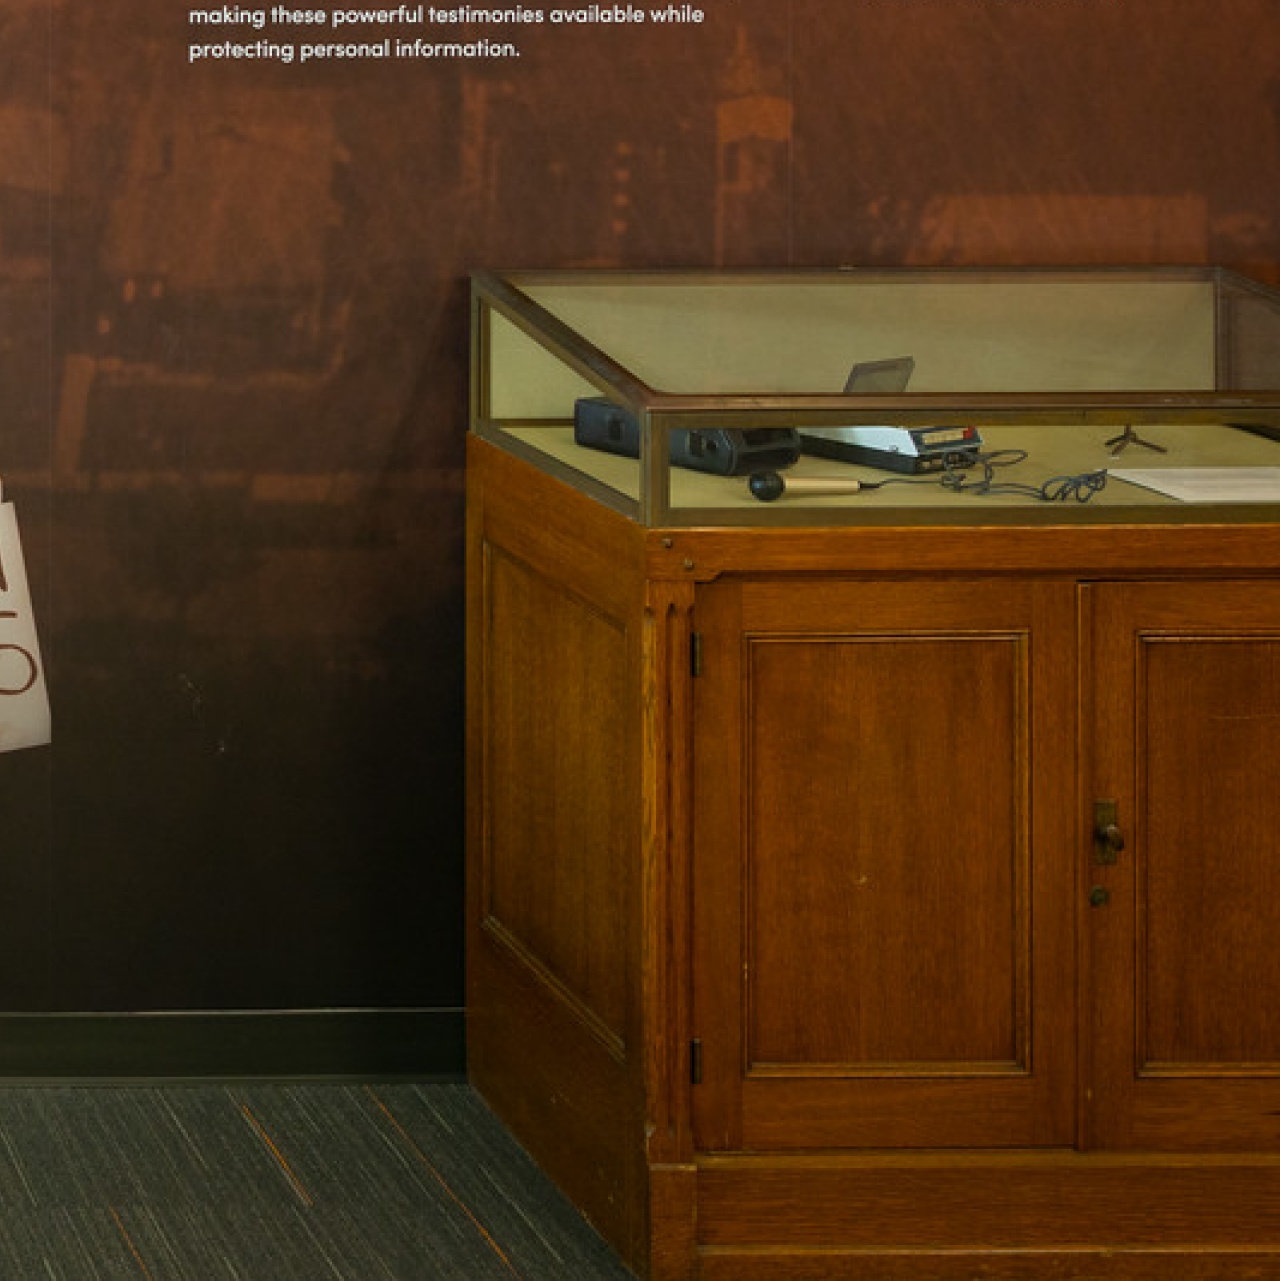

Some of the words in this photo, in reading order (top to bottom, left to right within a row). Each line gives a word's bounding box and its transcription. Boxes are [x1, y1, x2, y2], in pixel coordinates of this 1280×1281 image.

[190, 5, 266, 30] making
[272, 5, 328, 25] these
[332, 5, 424, 28] powerful
[428, 5, 544, 23] testimonies
[550, 5, 645, 23] available
[651, 5, 705, 23] while
[190, 39, 295, 64] protecting
[301, 39, 390, 64] personal
[397, 39, 520, 57] information.
